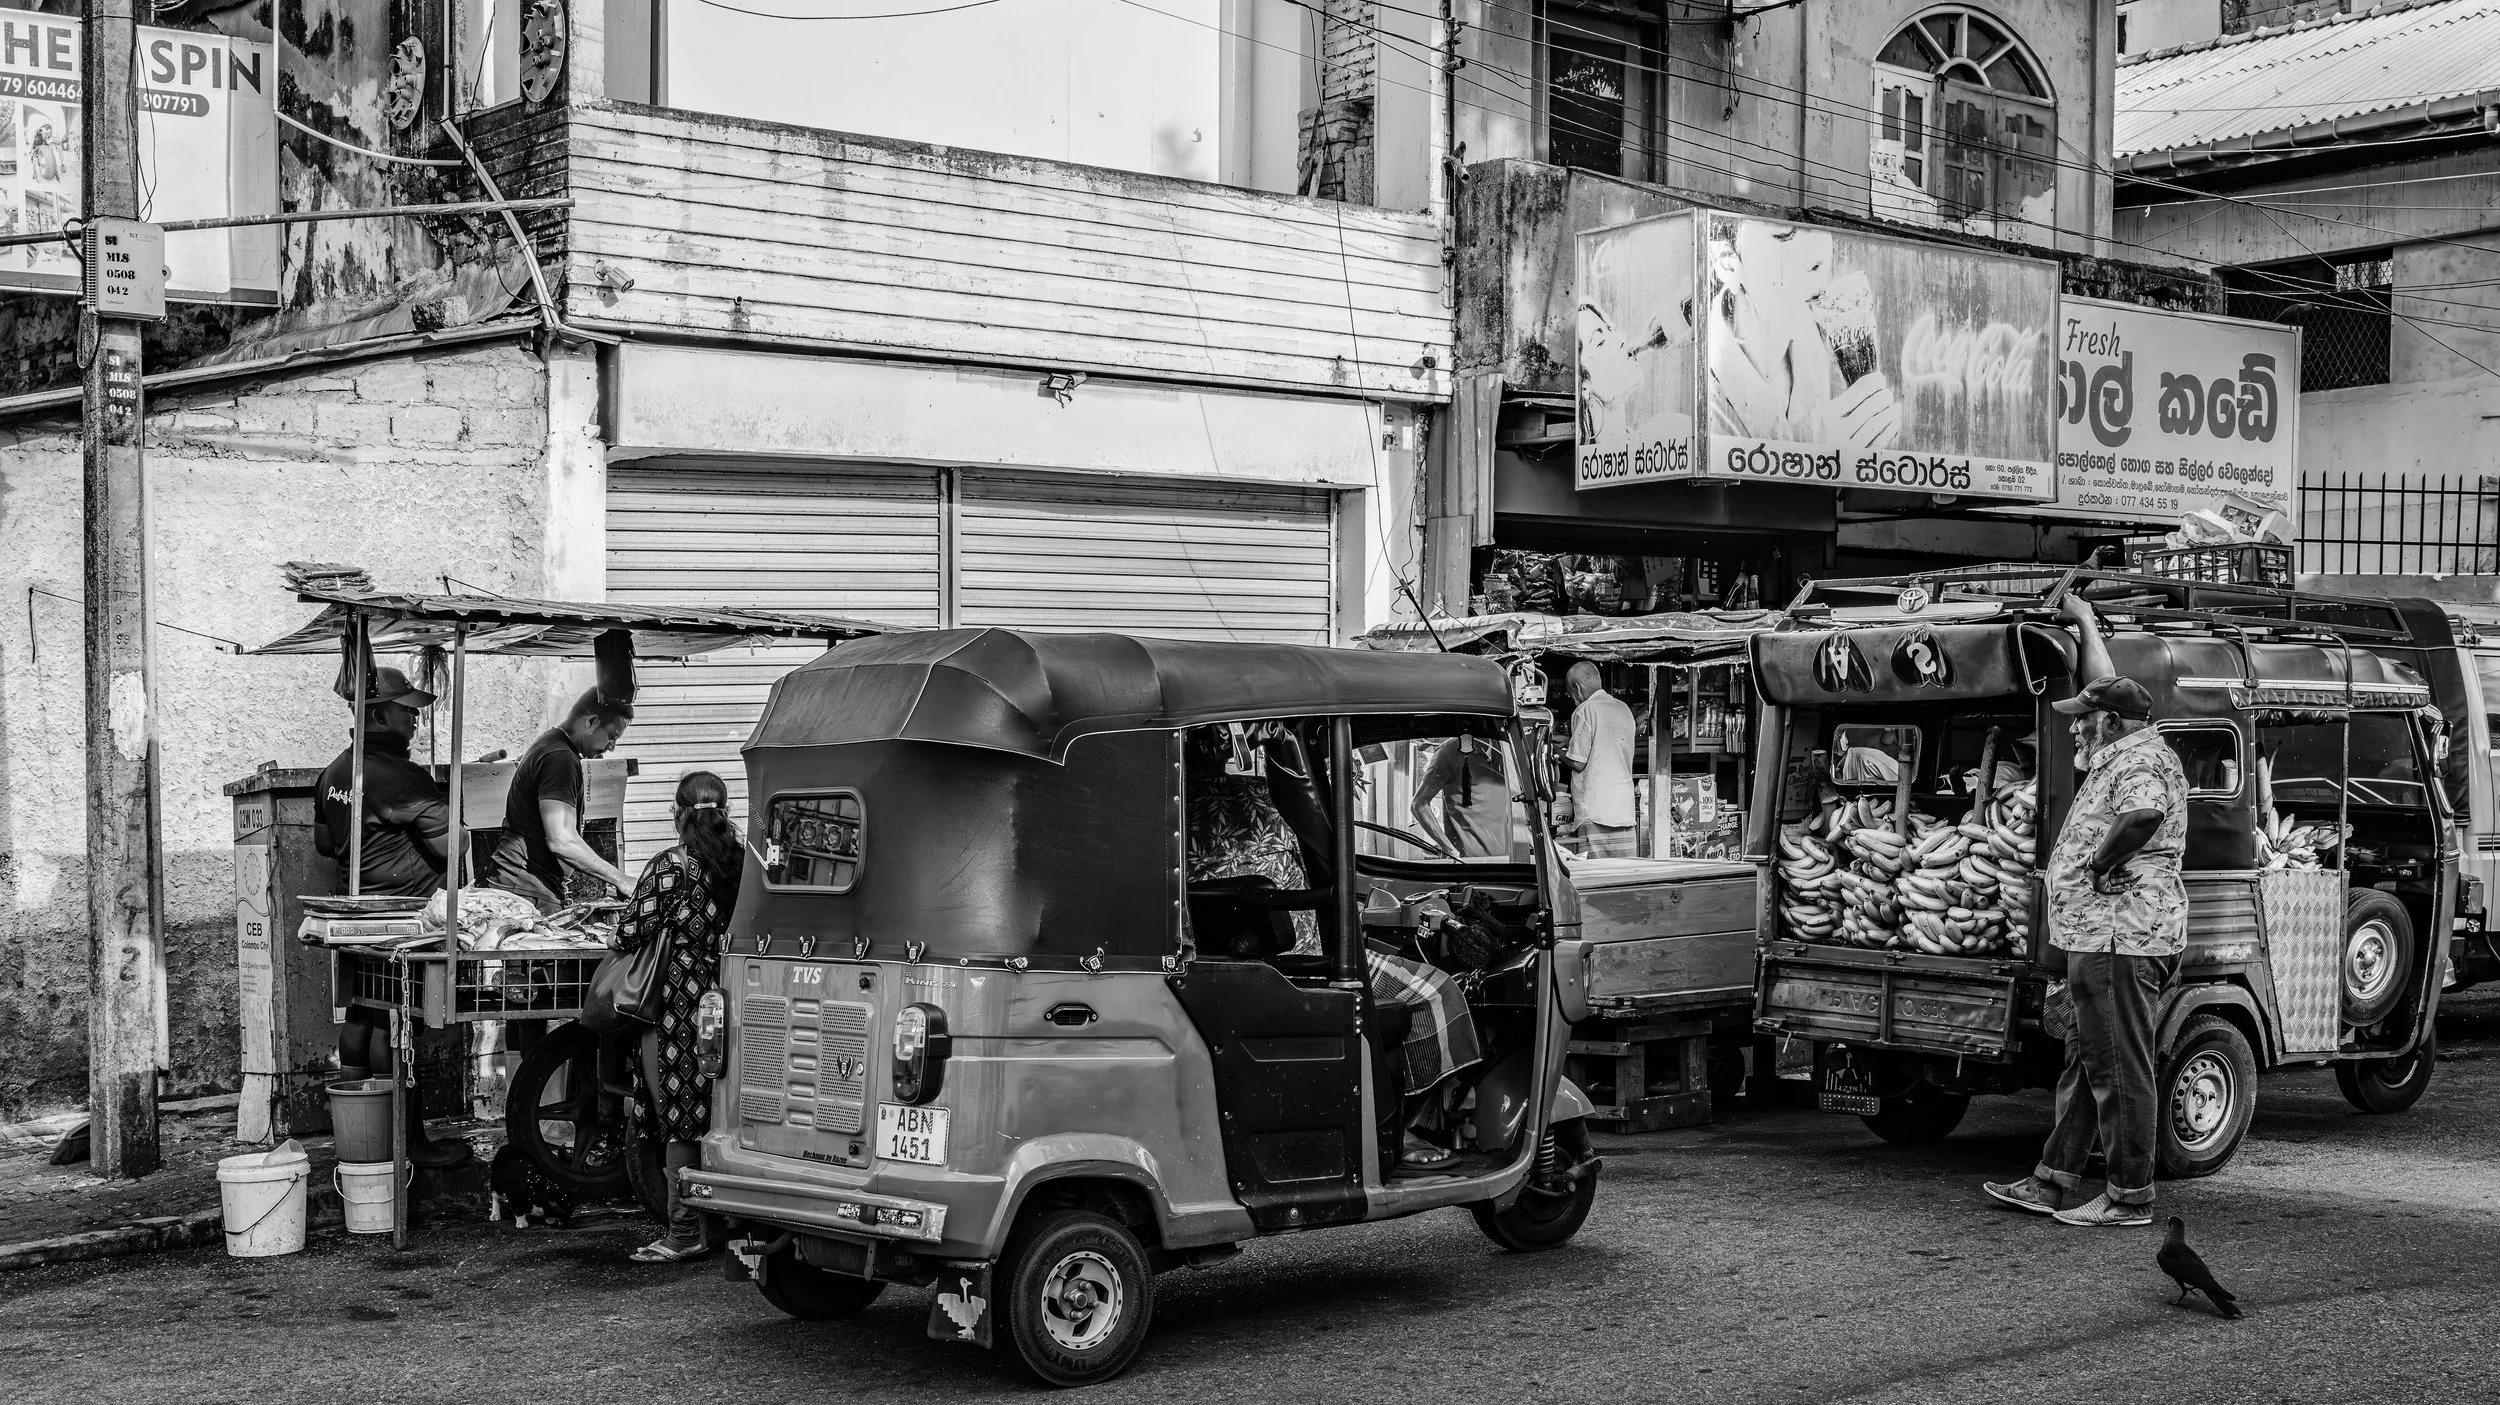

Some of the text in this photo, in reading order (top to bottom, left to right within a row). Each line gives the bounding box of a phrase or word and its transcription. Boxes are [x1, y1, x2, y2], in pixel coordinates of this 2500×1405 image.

[150, 39, 261, 95] SPIN
[106, 269, 136, 280] 0508
[107, 285, 129, 296] 042
[2066, 317, 2121, 358] Fresh
[109, 388, 137, 400] 0508
[109, 404, 132, 416] 042
[2121, 494, 2137, 507] 077
[2139, 496, 2155, 509] 434
[2157, 498, 2168, 509] 55
[2170, 499, 2179, 510] 19
[246, 922, 263, 937] CEB
[793, 965, 823, 985] TVS
[896, 1107, 934, 1134] ABN
[891, 1134, 930, 1161] 1451
